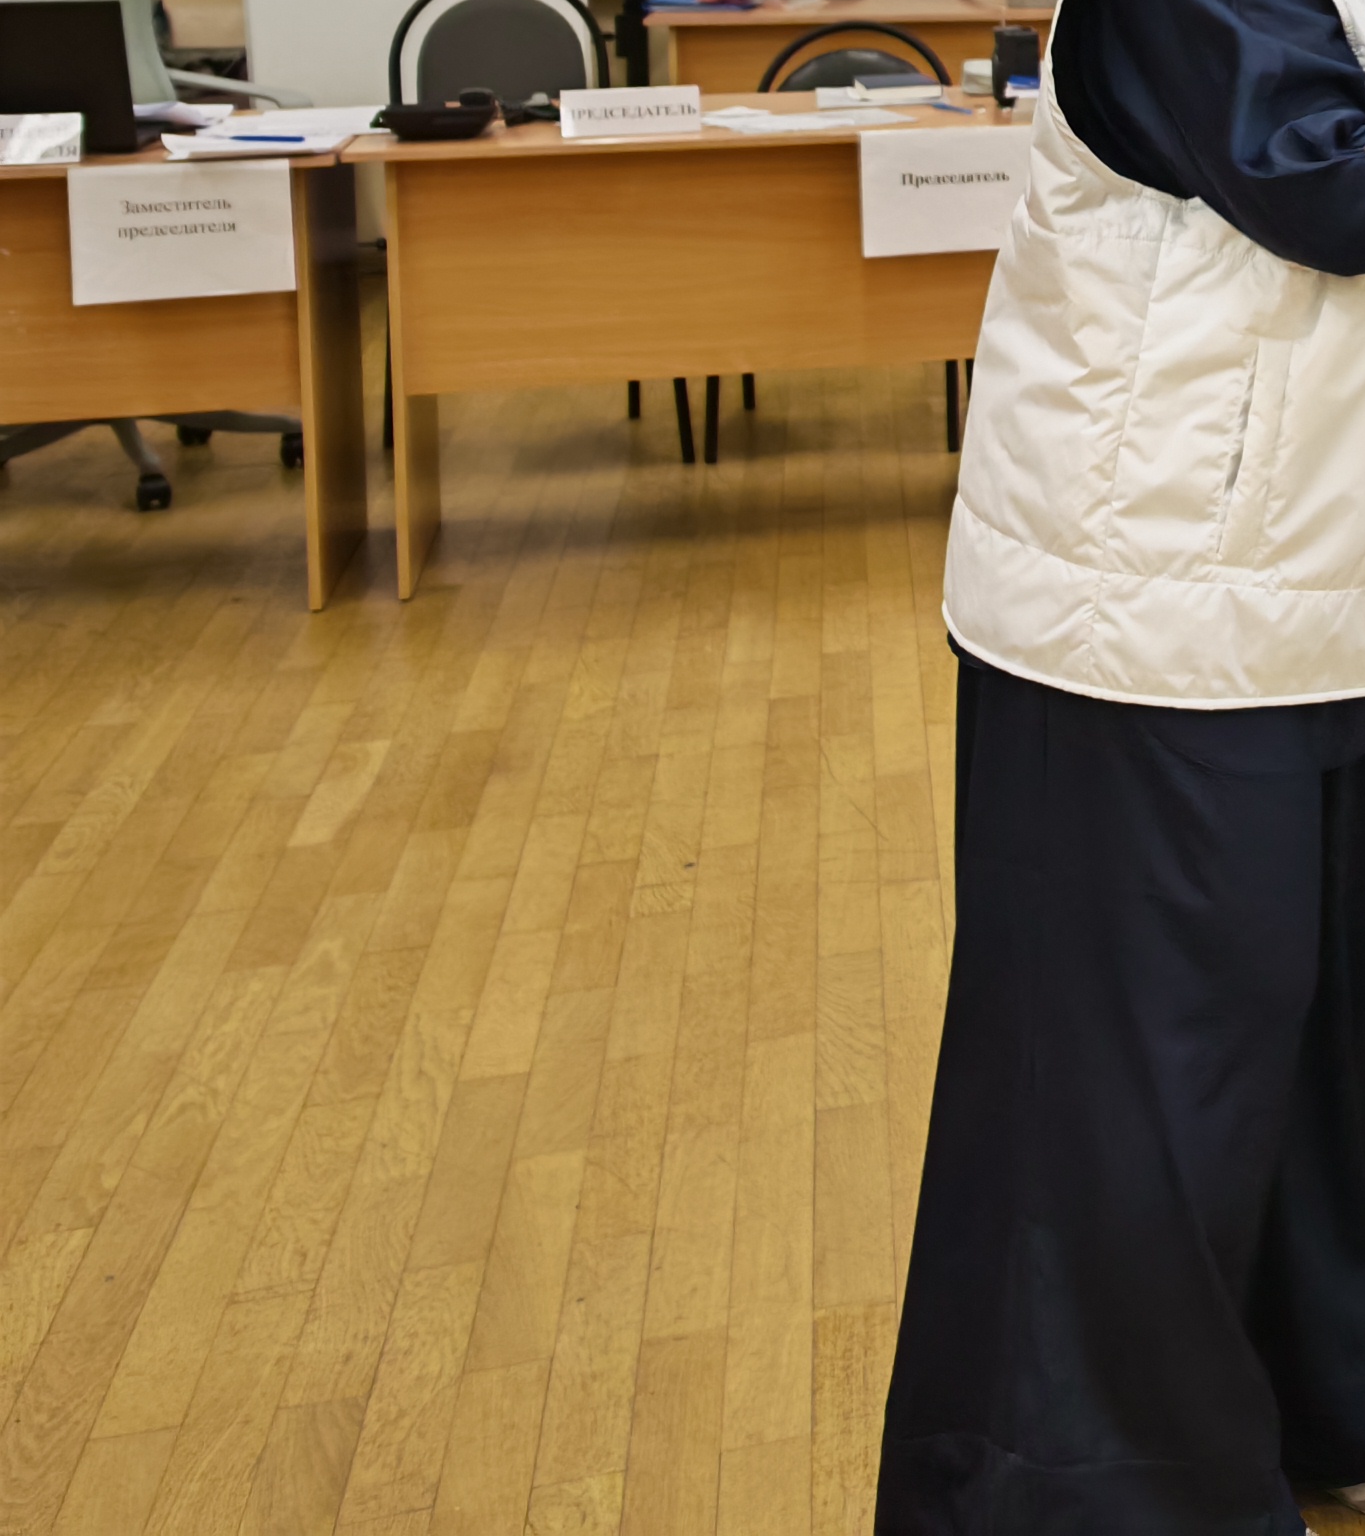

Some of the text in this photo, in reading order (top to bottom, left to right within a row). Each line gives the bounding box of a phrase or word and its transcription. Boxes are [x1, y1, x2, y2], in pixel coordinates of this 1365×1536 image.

[902, 171, 1010, 189] Председатель
[120, 198, 232, 215] Заместитель
[118, 221, 236, 240] председателя
